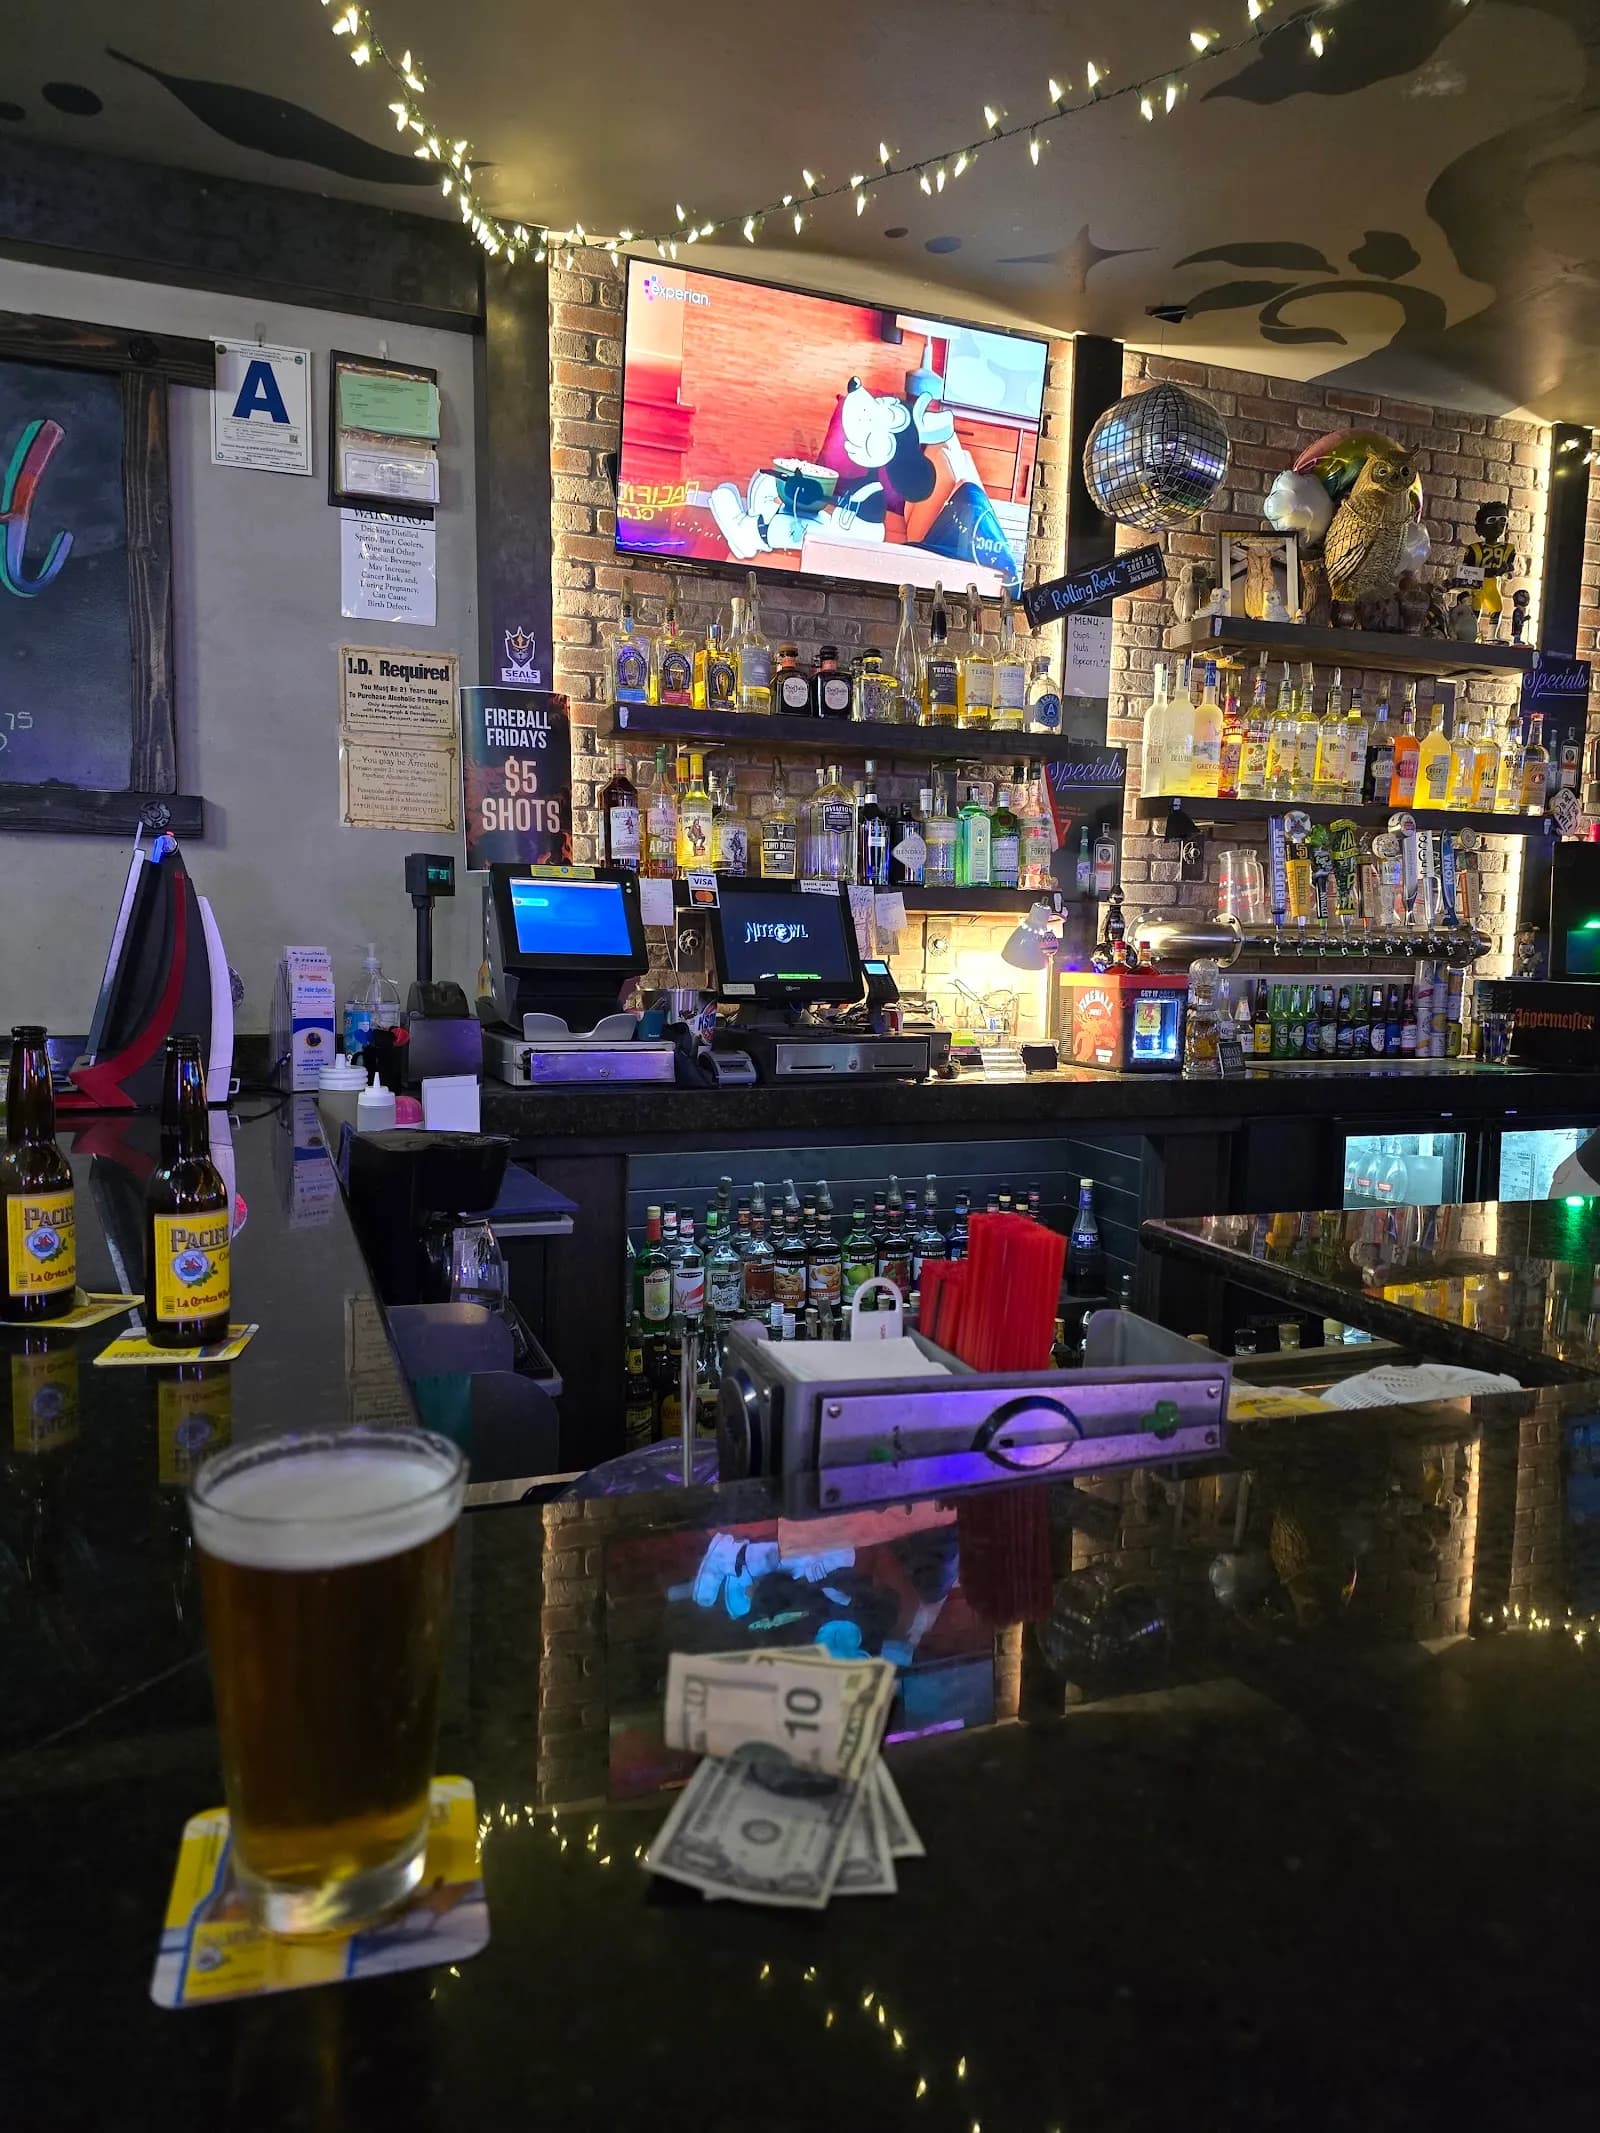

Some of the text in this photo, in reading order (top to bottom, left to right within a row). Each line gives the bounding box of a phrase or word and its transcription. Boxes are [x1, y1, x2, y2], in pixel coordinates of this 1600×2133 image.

[232, 360, 291, 424] A
[360, 524, 419, 539] Drinking Distilled
[365, 543, 415, 556] Wine and Other
[390, 556, 422, 567] Beverages
[1147, 556, 1155, 565] OF
[1481, 547, 1505, 569] 29
[368, 562, 411, 574] May Increase
[361, 571, 384, 580] Cancer
[372, 590, 407, 601] Can Cause
[1051, 583, 1094, 611] Rolling
[367, 599, 385, 608] Birth
[1074, 616, 1099, 626] MENU
[348, 657, 450, 682] I.D. Required
[505, 669, 538, 679] SEALS
[360, 683, 372, 691] You
[410, 687, 426, 695] Years
[357, 692, 386, 701] Purchase
[388, 694, 416, 703] Alcoholic
[417, 696, 449, 705] Beverages
[485, 708, 551, 730] FIREBALL
[487, 728, 547, 748] FRIDAYS
[362, 755, 377, 764] You
[397, 757, 405, 766] be
[505, 756, 537, 796] $5
[1047, 752, 1124, 791] Specials
[482, 798, 560, 833] SHOTS
[649, 840, 677, 853] APPLE
[1275, 829, 1285, 900] BUD LIGHT
[1445, 854, 1455, 885] KONA
[693, 878, 713, 886] VISA
[1140, 989, 1152, 997] GET
[1078, 1234, 1099, 1242] BOLS
[784, 1687, 822, 1739] 10
